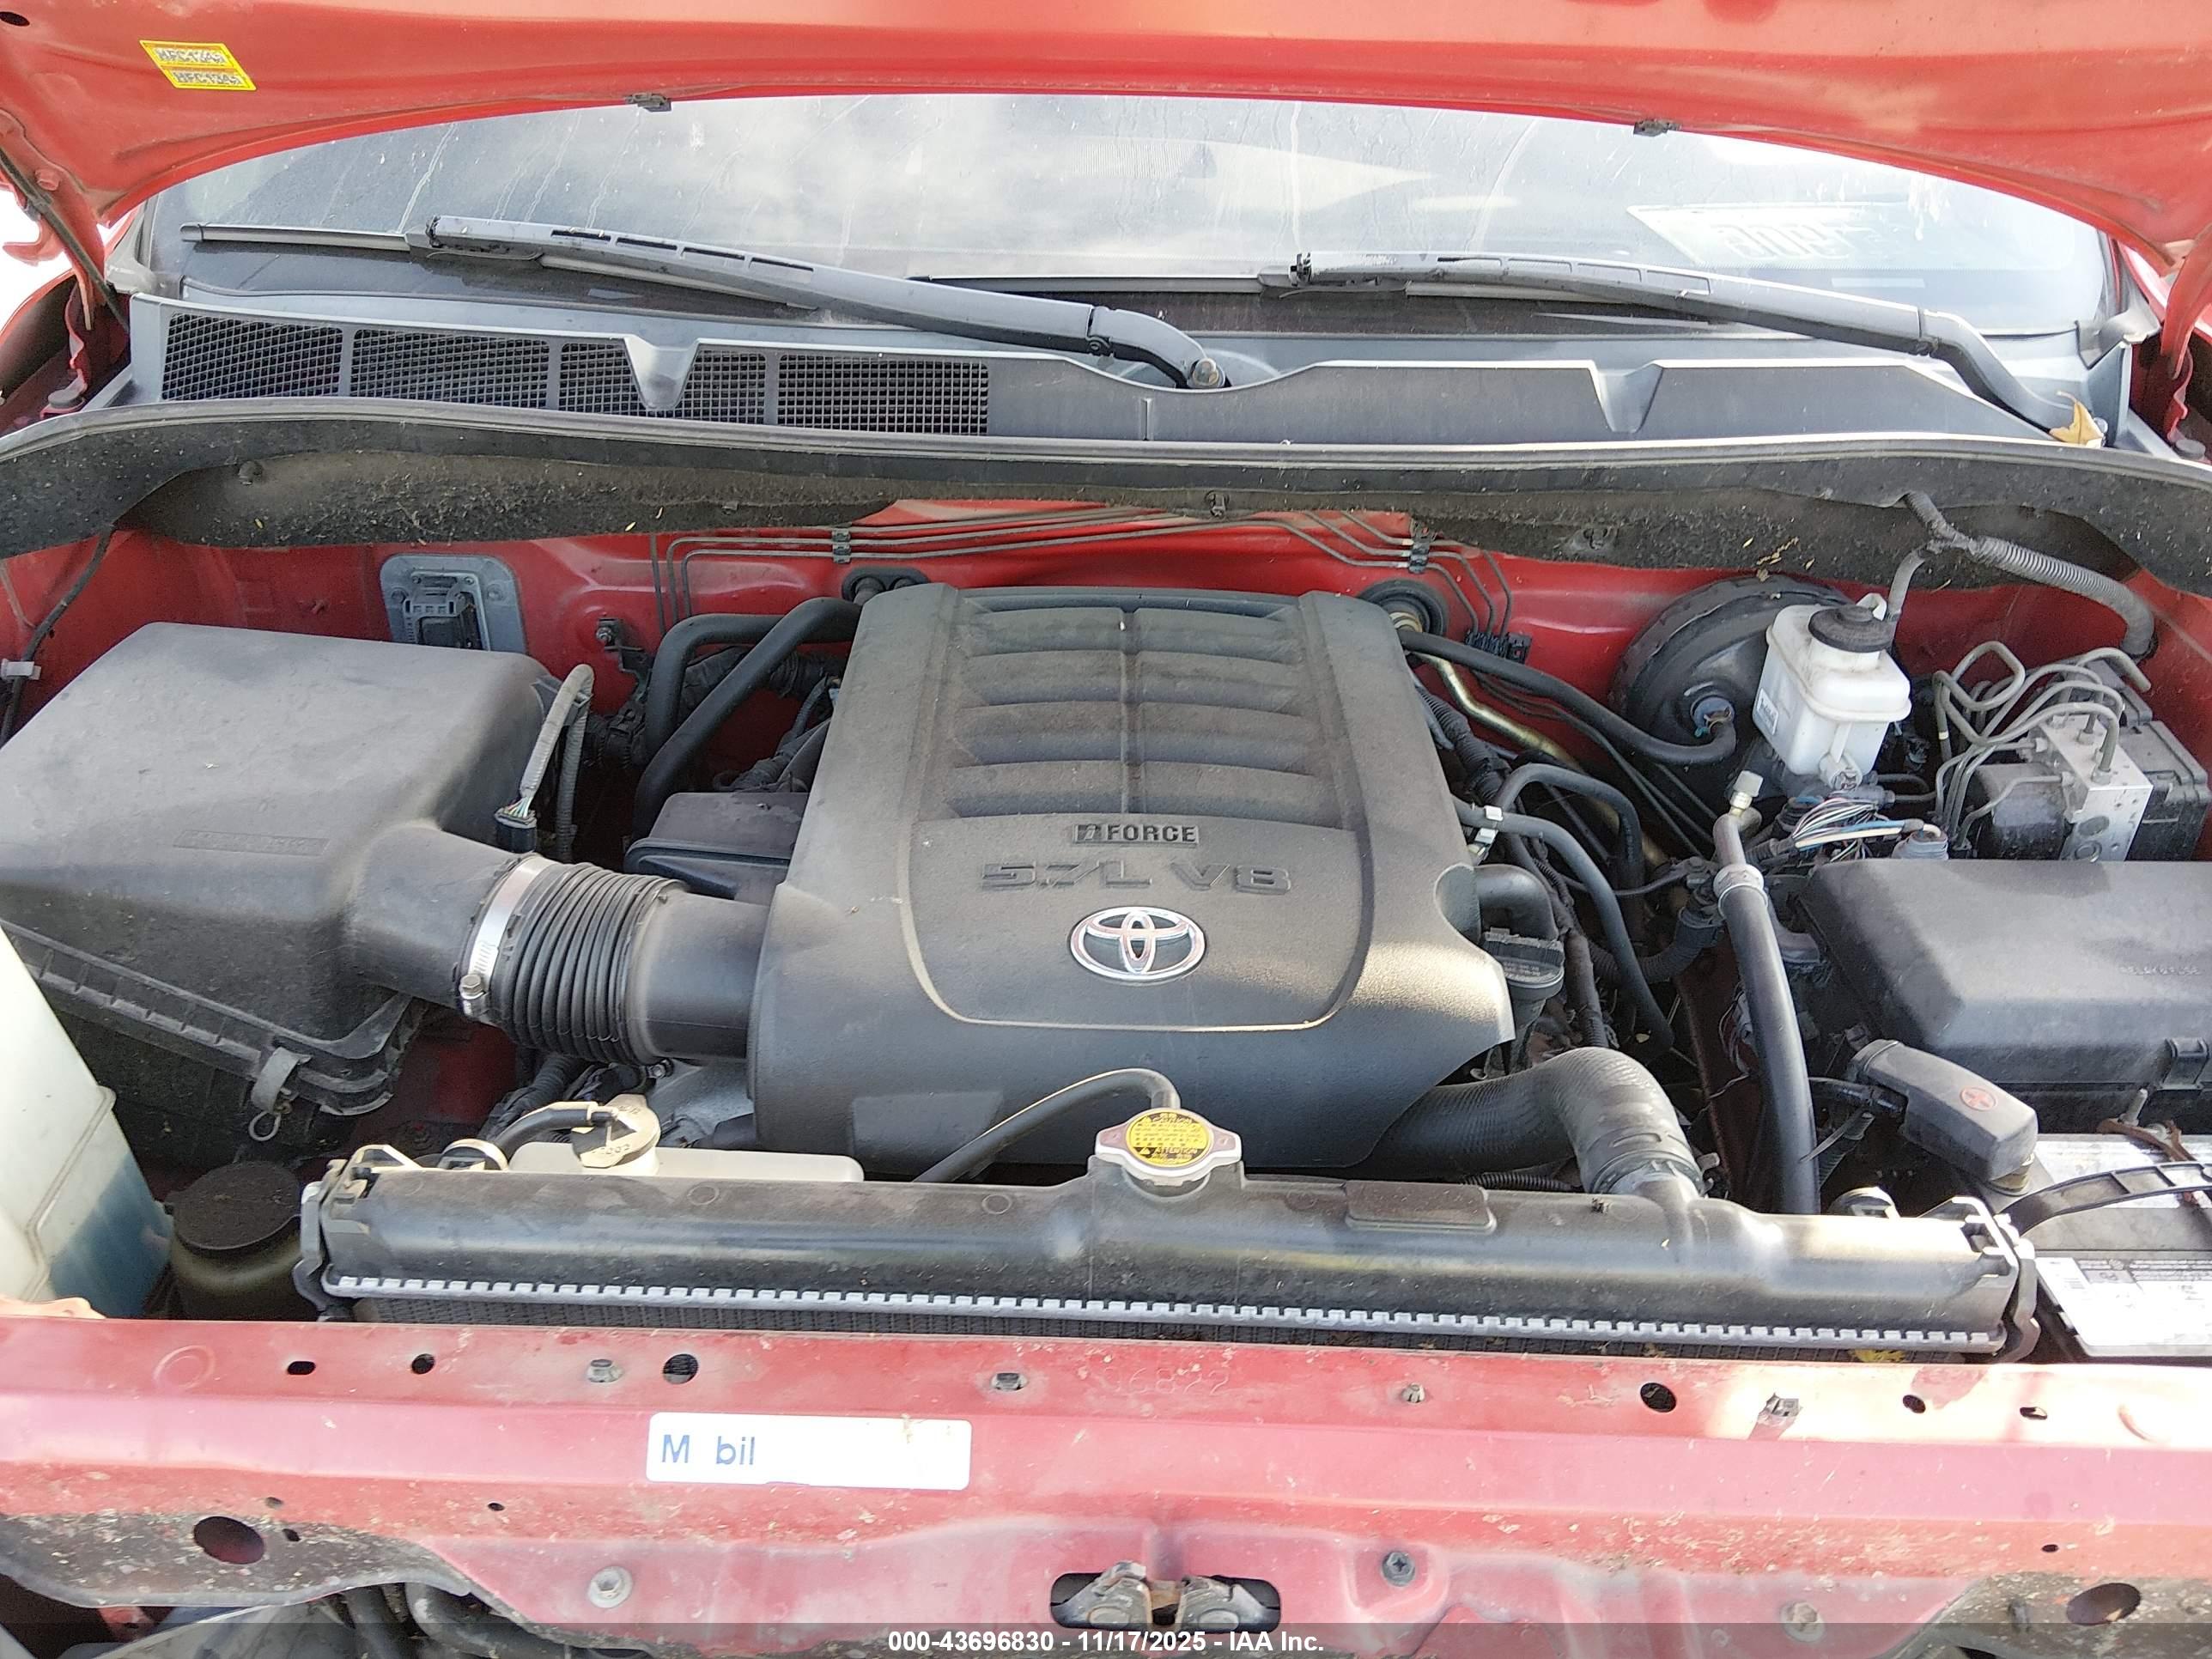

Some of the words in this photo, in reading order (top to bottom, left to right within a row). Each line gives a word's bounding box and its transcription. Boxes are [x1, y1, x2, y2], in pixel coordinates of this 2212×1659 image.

[1107, 824, 1196, 842] FORCE
[981, 859, 1152, 890] 5.7L
[1170, 862, 1292, 895] V8
